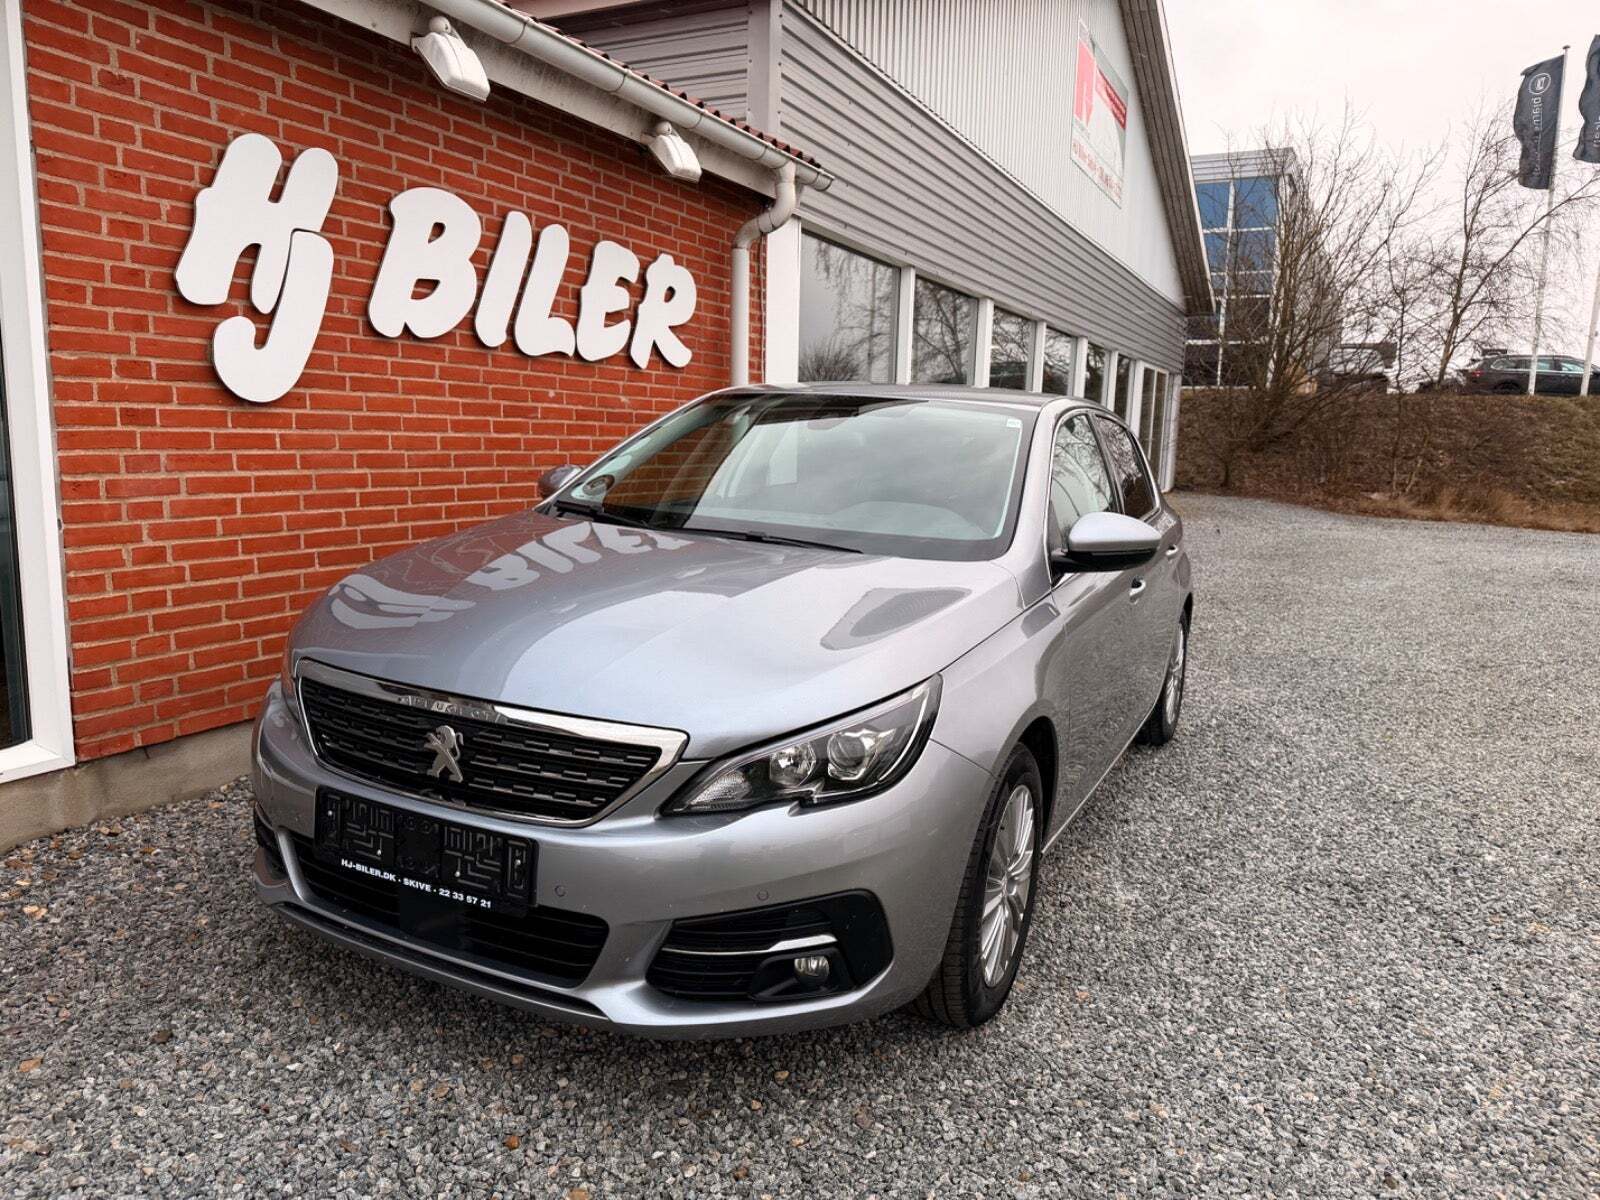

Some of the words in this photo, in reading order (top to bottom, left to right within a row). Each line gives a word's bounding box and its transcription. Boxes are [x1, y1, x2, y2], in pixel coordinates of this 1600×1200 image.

[174, 132, 339, 402] HJ
[368, 187, 697, 370] BILER
[341, 858, 397, 882] HJ-BILER.DK
[403, 877, 432, 893] SKIVE
[438, 887, 451, 898] 22
[452, 891, 465, 902] 33
[466, 895, 478, 905] 57
[480, 899, 492, 909] 21
